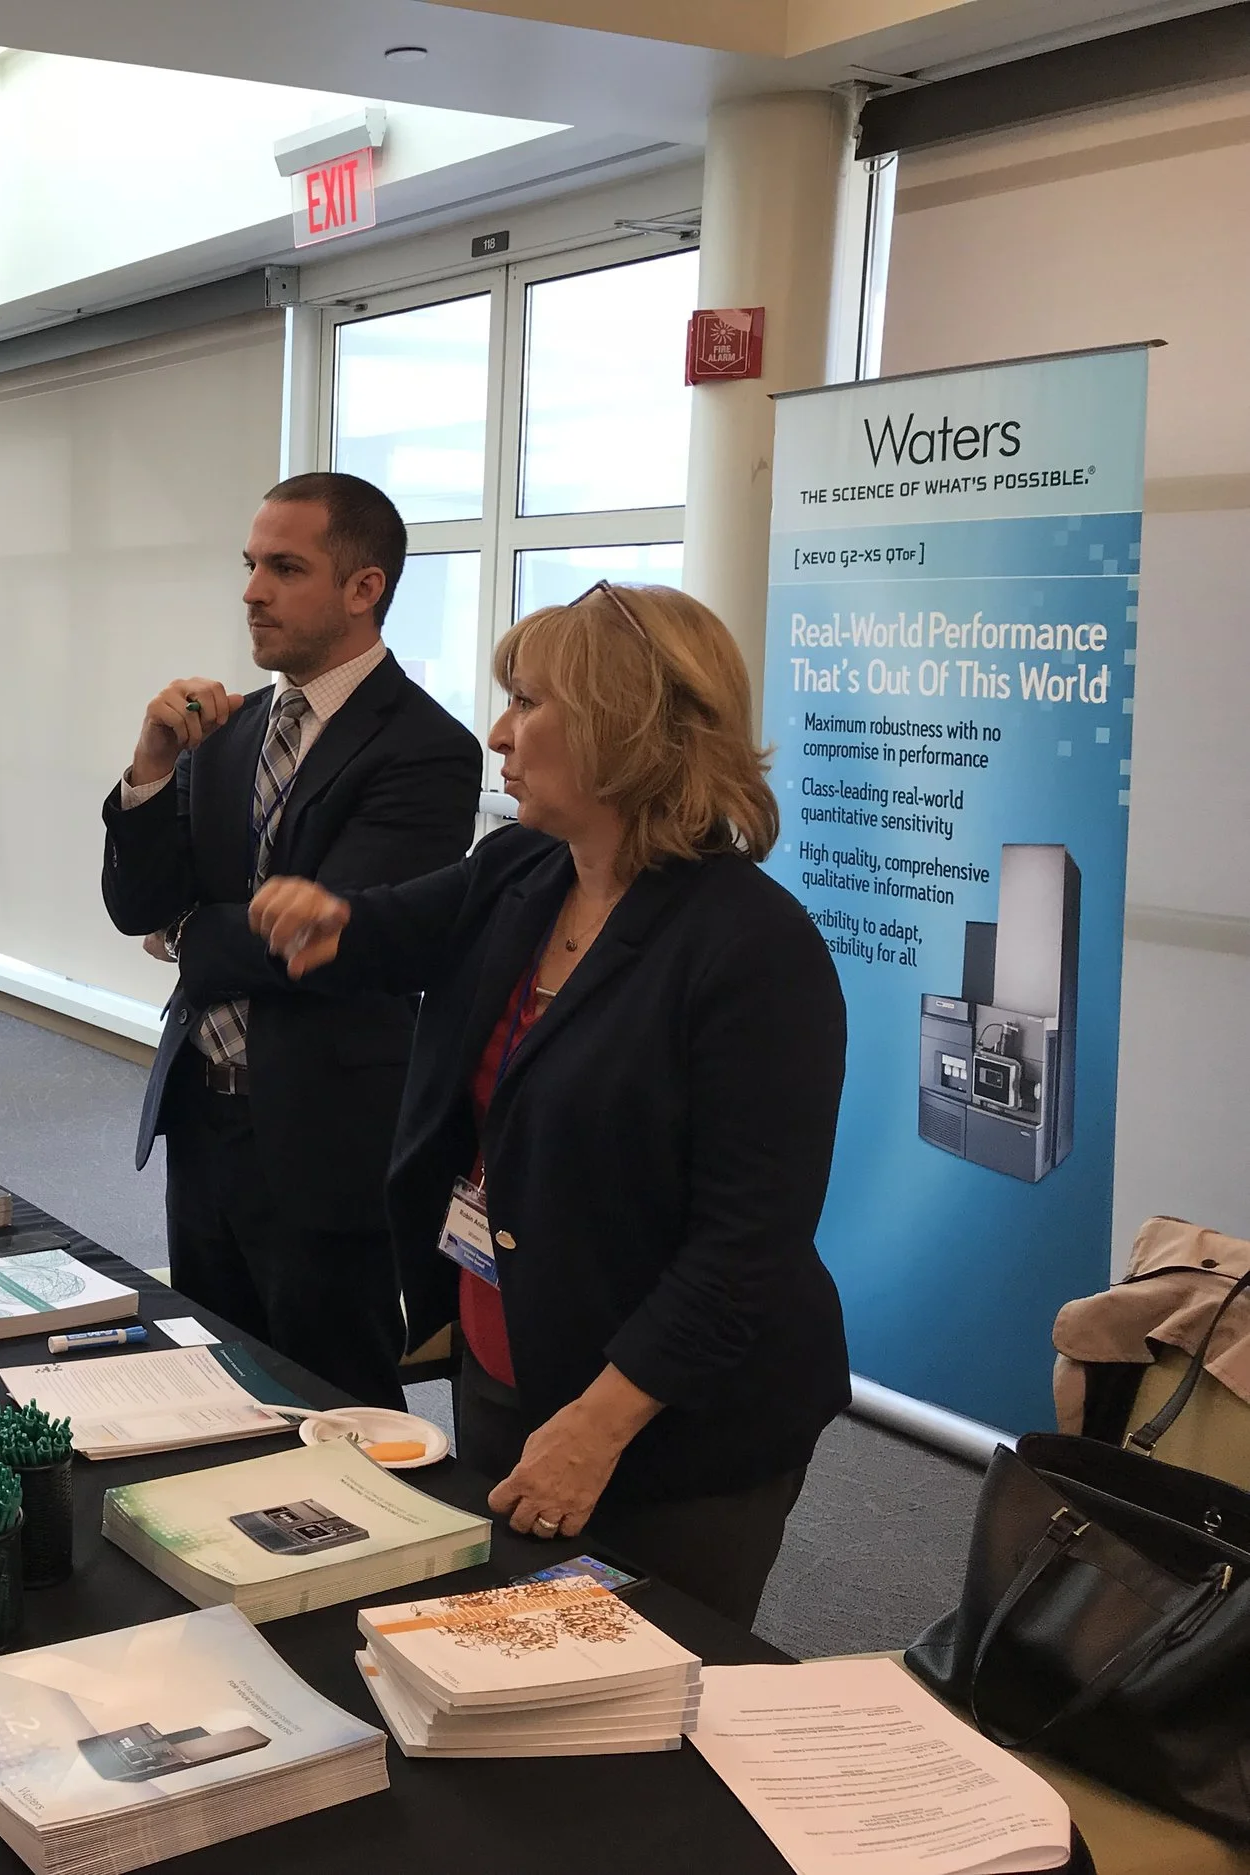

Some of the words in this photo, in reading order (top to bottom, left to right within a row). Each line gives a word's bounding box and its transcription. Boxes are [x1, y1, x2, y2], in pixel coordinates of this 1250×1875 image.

[307, 159, 358, 234] EXIT
[483, 238, 496, 250] 118
[707, 353, 736, 362] ALARM
[713, 345, 731, 353] FIRE
[864, 413, 1021, 468] Waters
[800, 490, 827, 505] THE
[832, 483, 894, 503] SCIENCE
[900, 481, 921, 498] OF
[925, 475, 987, 495] WHAT'S
[841, 549, 881, 567] G2-XS
[790, 612, 923, 648] Real-World
[929, 611, 1108, 652] Performance
[790, 658, 859, 694] That’s
[867, 661, 910, 696] Out
[918, 659, 950, 697] Of
[956, 660, 1011, 700] This
[1019, 662, 1108, 704] World
[804, 712, 866, 734] Maximum
[870, 716, 943, 738] robustness
[946, 720, 978, 740] with
[982, 726, 1001, 742] no
[803, 741, 879, 761] compromise
[883, 744, 896, 762] in
[899, 745, 989, 768] performance
[802, 776, 888, 807] Class-leading
[892, 786, 964, 810] real-world
[801, 805, 878, 827] quantitative
[881, 813, 954, 841] sensitivity
[799, 841, 829, 866] High
[832, 847, 881, 873] quality,
[884, 855, 990, 883] comprehensive
[802, 869, 870, 893] qualitative
[873, 877, 954, 905] information
[863, 917, 876, 935] to
[879, 921, 923, 945] adapt,
[877, 942, 894, 963] for
[899, 948, 917, 967] all
